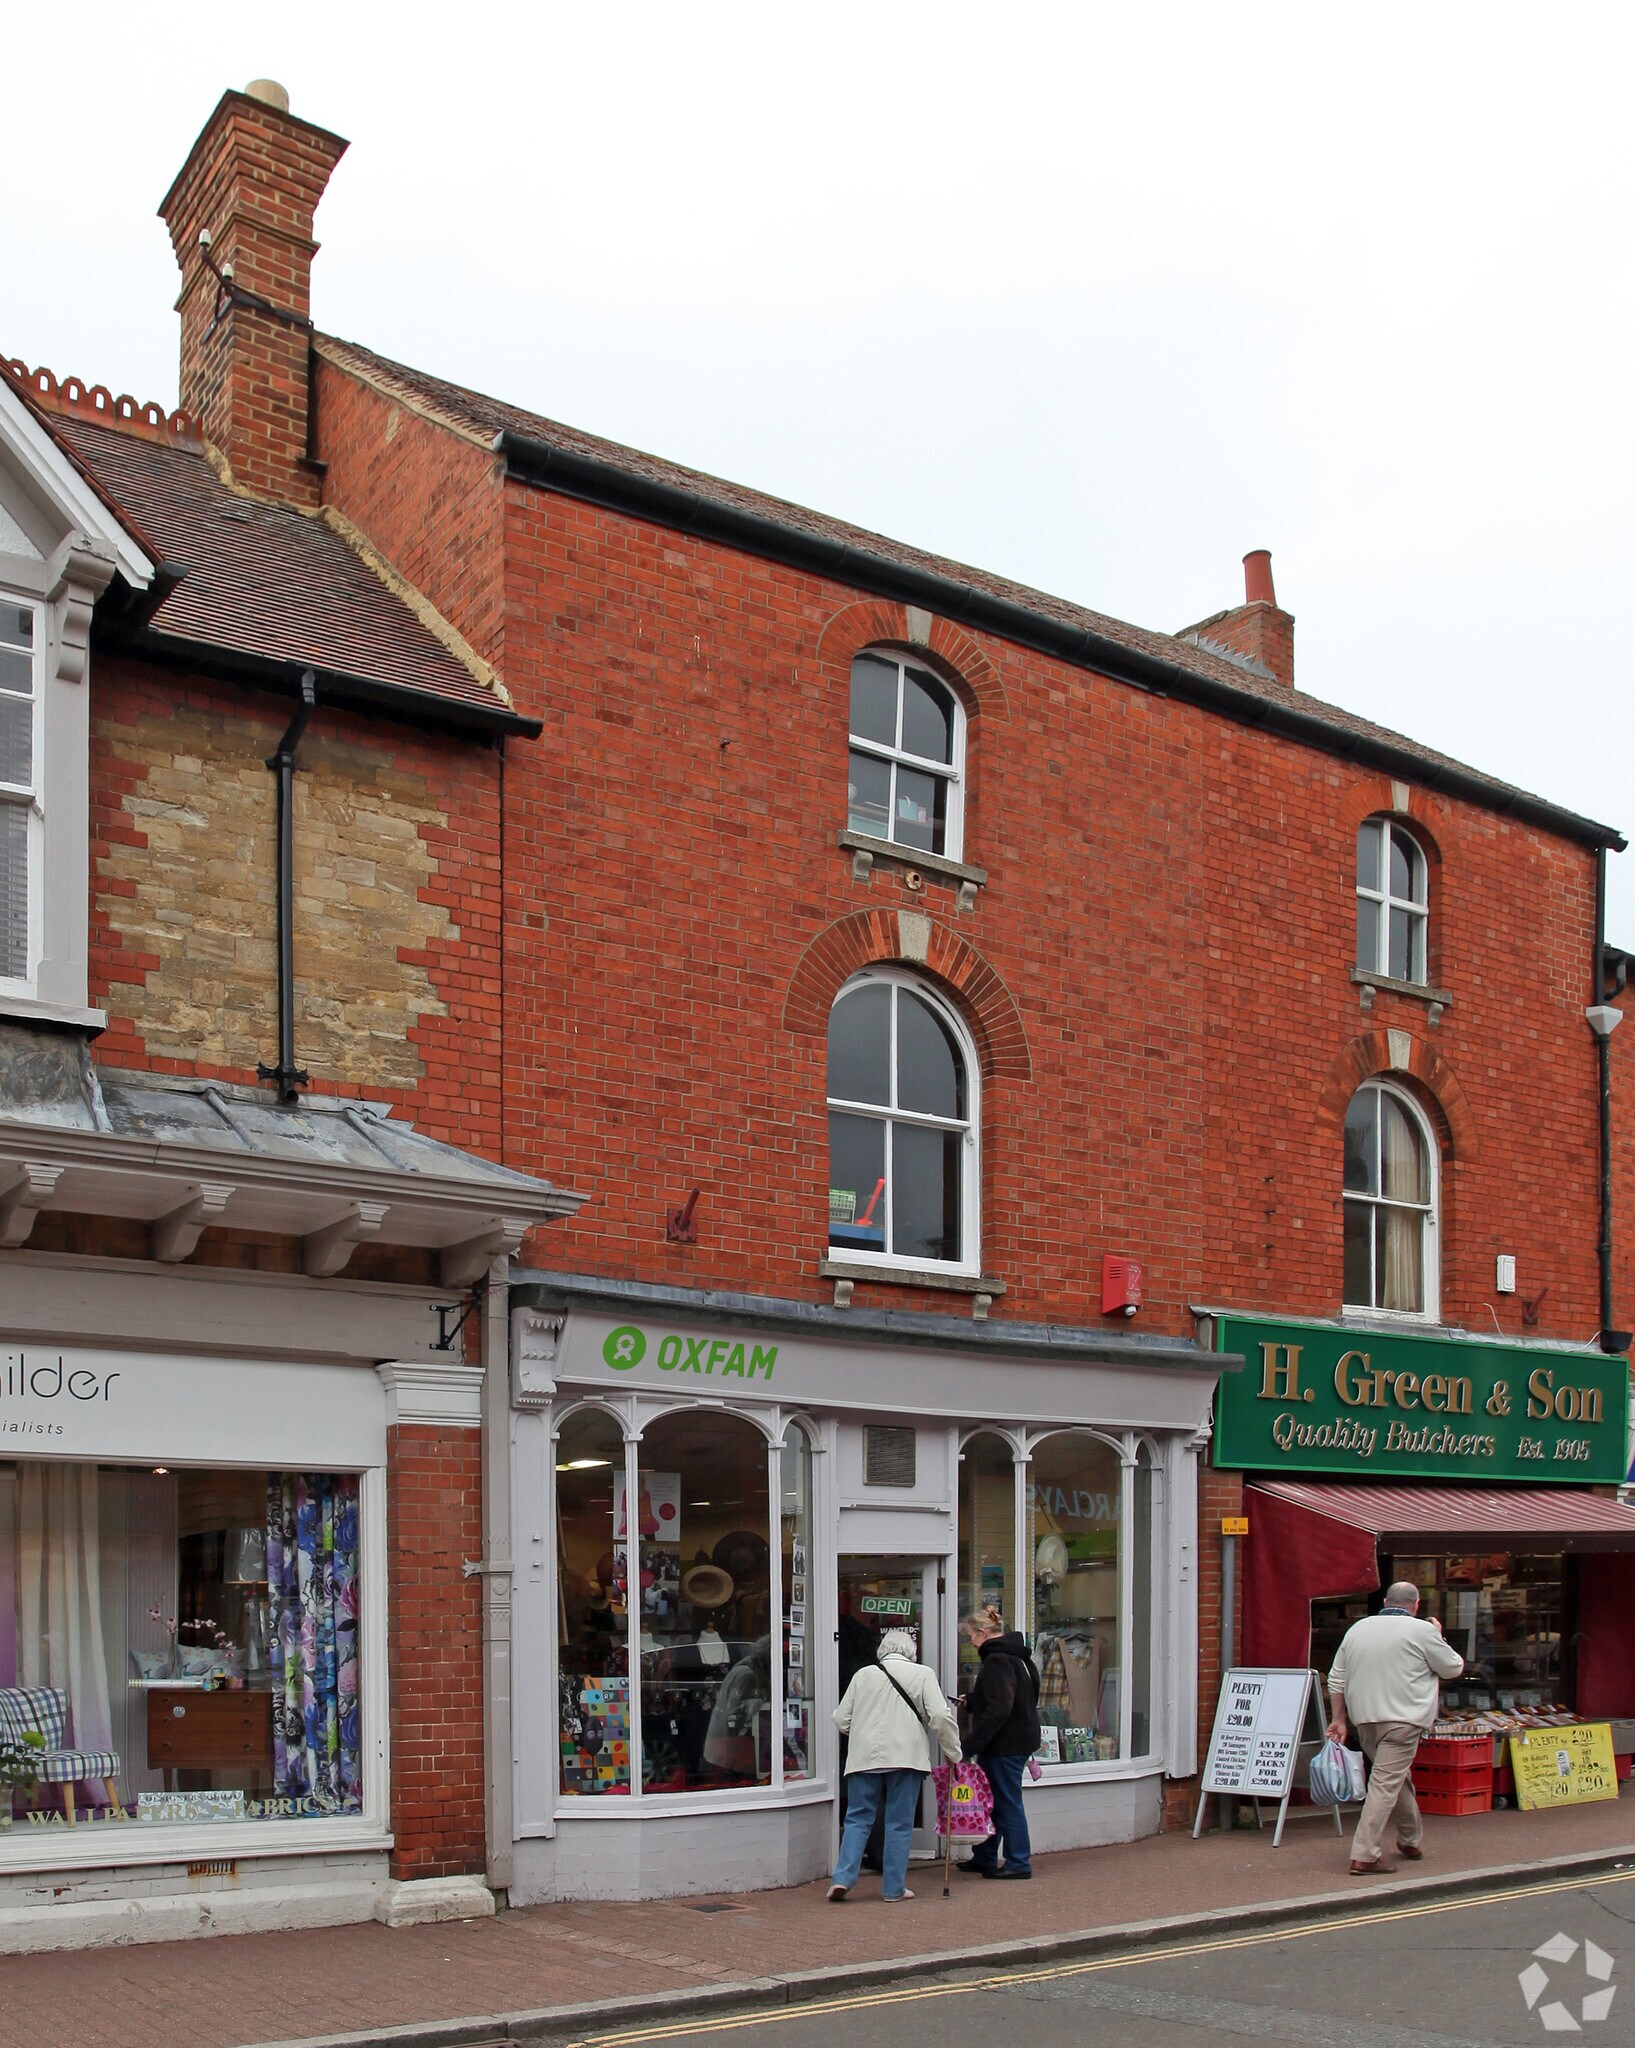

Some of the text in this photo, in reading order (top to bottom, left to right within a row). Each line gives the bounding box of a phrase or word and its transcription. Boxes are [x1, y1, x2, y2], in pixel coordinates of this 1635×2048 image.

[657, 1335, 778, 1380] OXFAM
[0, 1353, 120, 1401] ilder
[1257, 1341, 1604, 1423] H. Green & Son
[1273, 1412, 1591, 1462] Quality Butchers Est. 1905
[865, 1599, 908, 1613] OPEN
[1232, 1682, 1262, 1695] PLENTY
[1235, 1699, 1251, 1710] FOR
[1226, 1714, 1253, 1727] £20.00
[1065, 1728, 1087, 1736] 501
[1530, 1736, 1559, 1748] PLENTY
[1572, 1730, 1593, 1744] £20
[1214, 1777, 1239, 1786] £20.00
[1250, 1778, 1282, 1786] £20.00
[1578, 1775, 1603, 1794] £20
[956, 1788, 970, 1800] M
